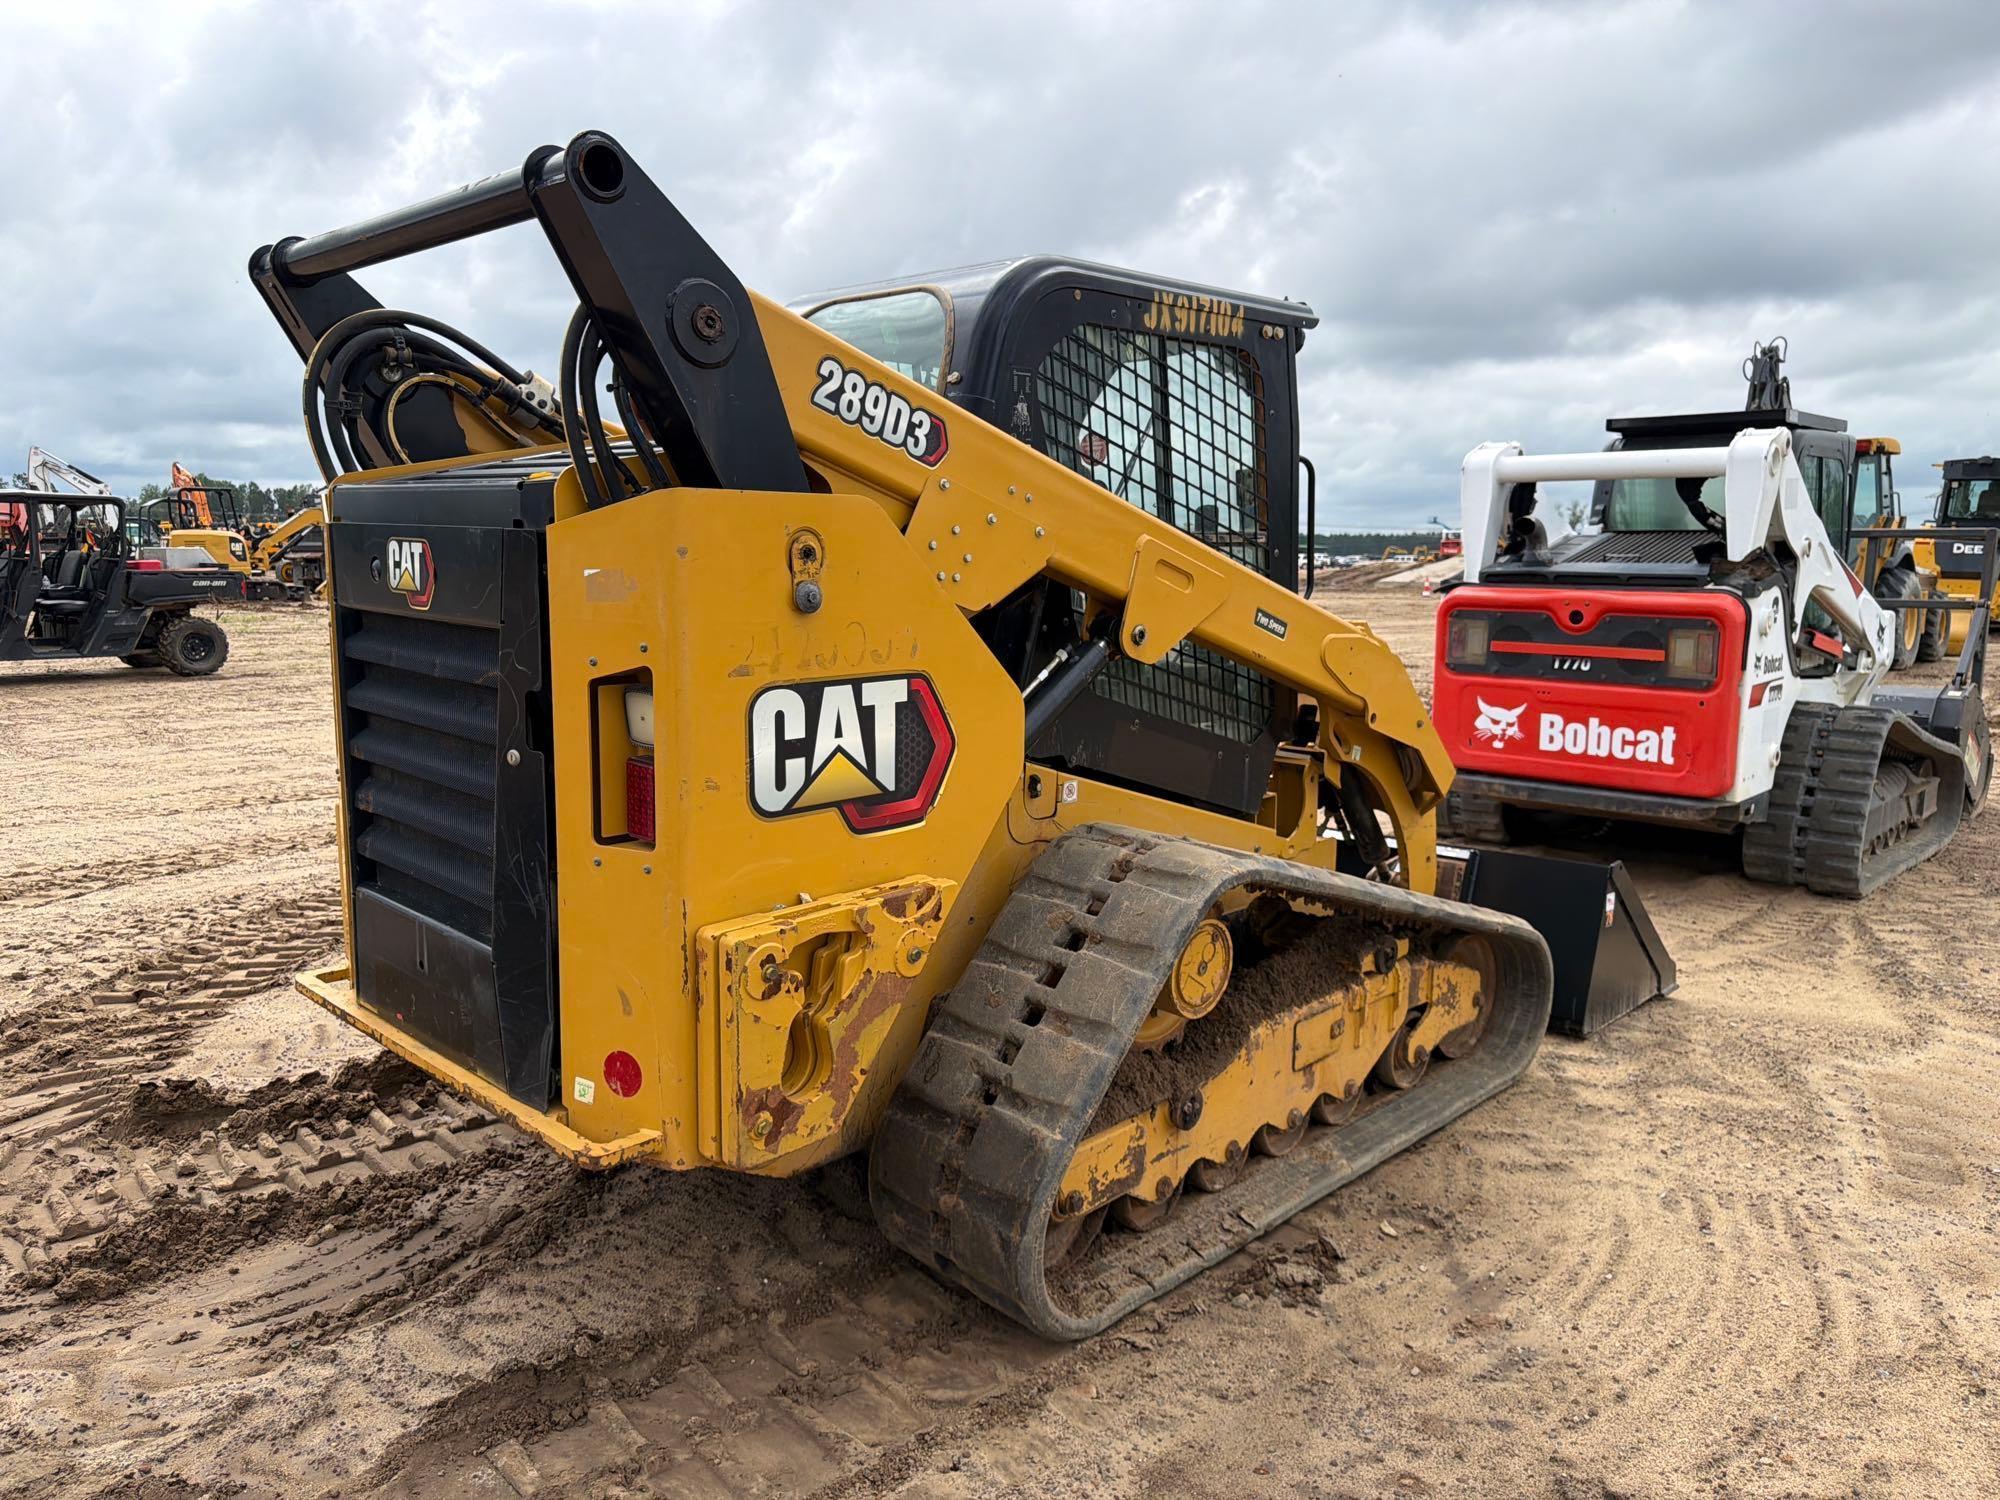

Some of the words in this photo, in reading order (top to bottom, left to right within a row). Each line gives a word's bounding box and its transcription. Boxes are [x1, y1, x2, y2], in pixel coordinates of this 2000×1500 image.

[1144, 288, 1245, 337] JX917104
[813, 359, 931, 457] 289D3
[231, 542, 243, 551] CAT
[389, 540, 422, 591] CAT
[1952, 543, 1984, 555] DEE
[752, 678, 908, 812] CAT
[1539, 713, 1676, 765] Bobcat
